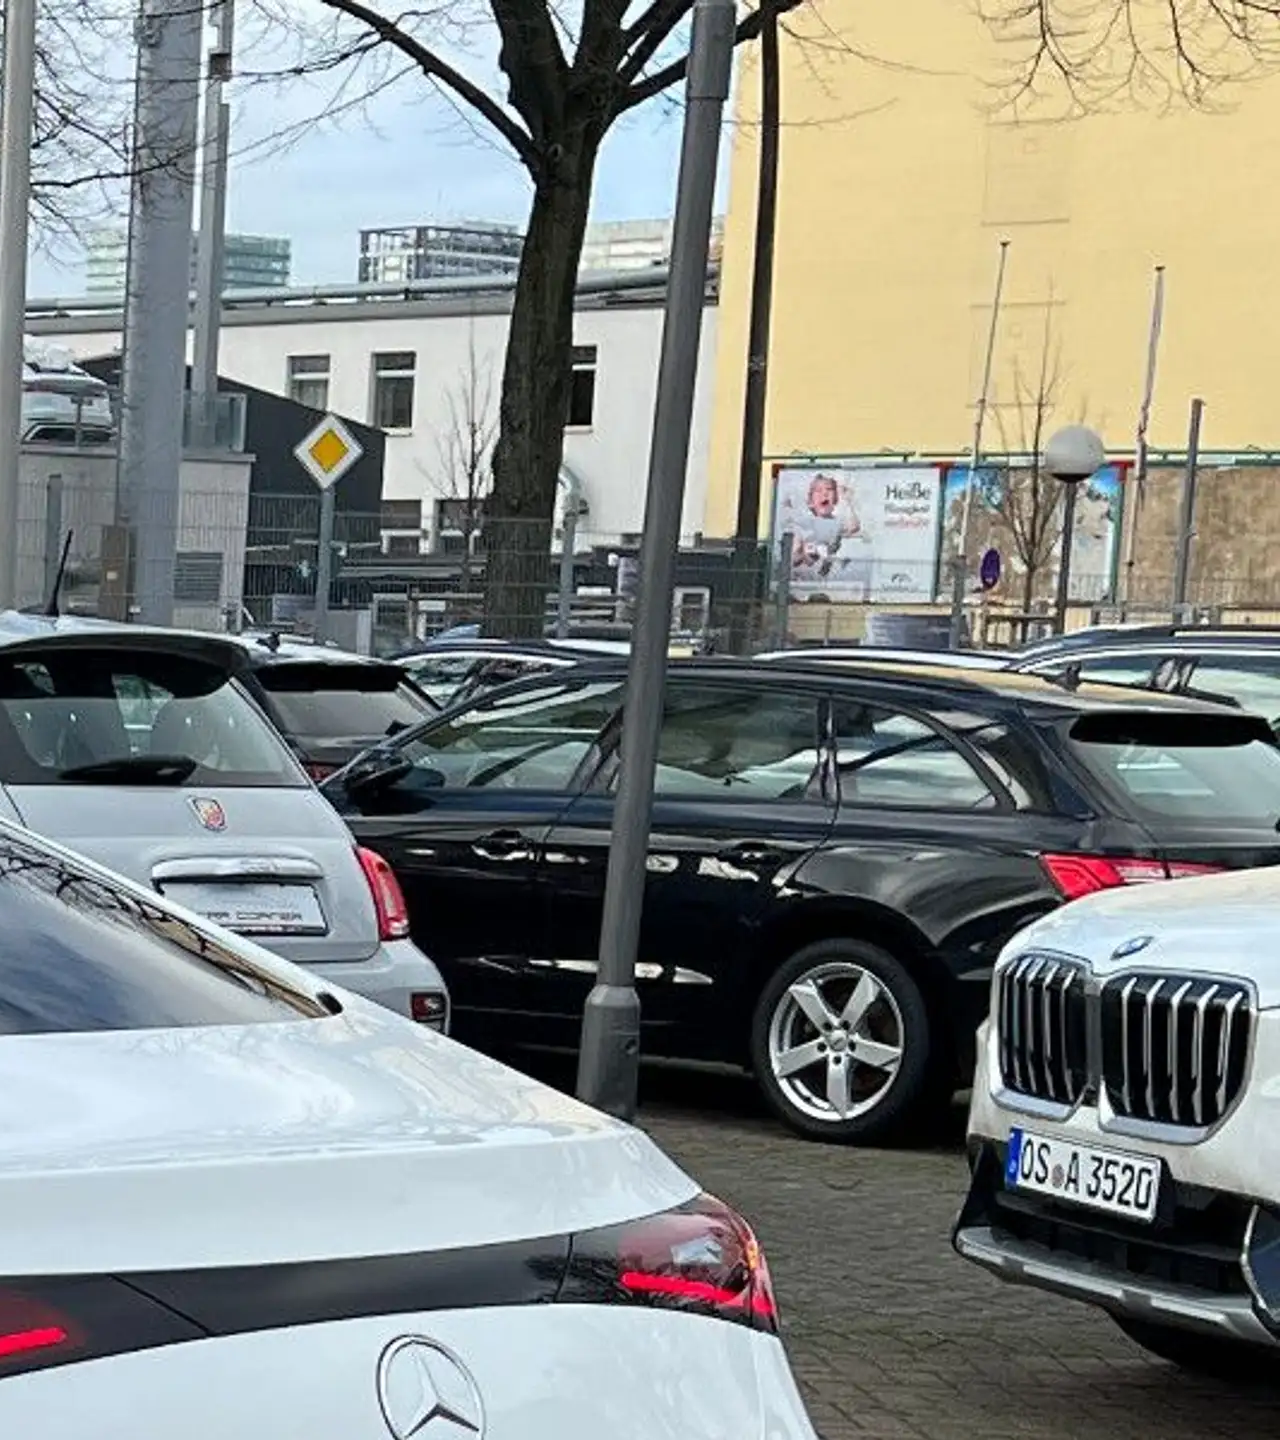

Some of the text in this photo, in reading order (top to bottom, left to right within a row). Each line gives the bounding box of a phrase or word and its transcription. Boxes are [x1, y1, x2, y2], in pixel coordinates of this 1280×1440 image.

[1020, 1138, 1154, 1210] OS A 3520
